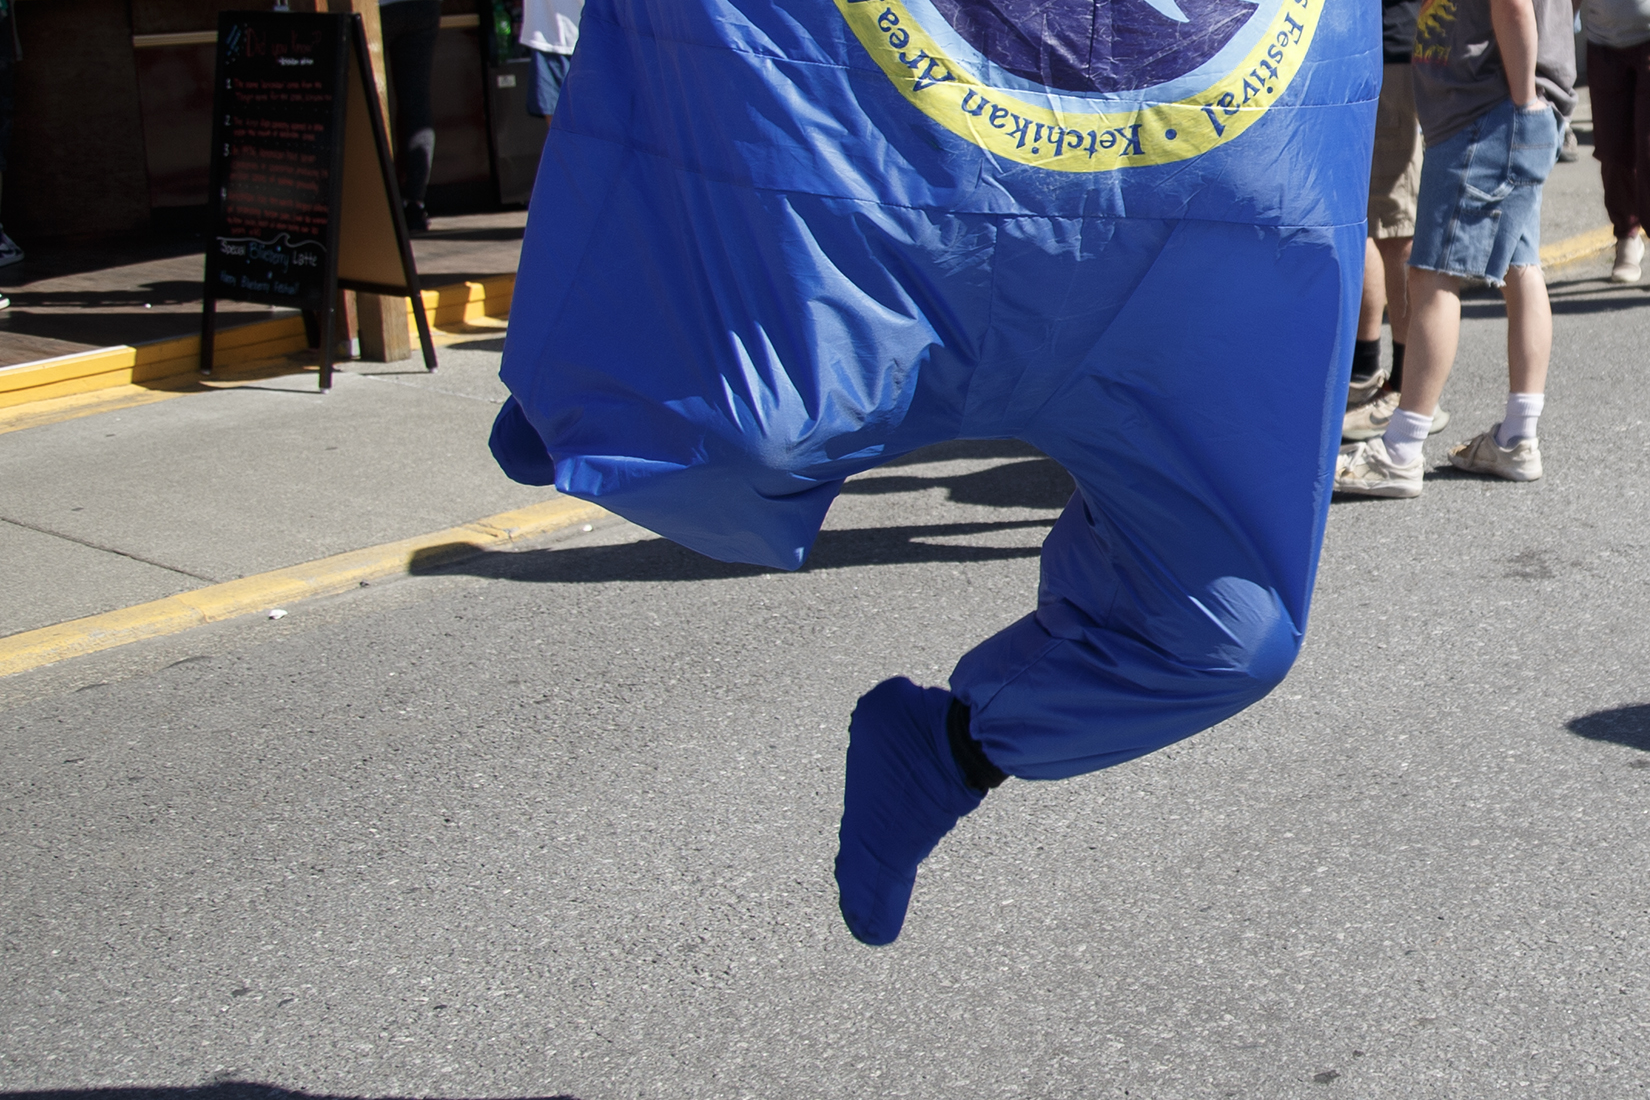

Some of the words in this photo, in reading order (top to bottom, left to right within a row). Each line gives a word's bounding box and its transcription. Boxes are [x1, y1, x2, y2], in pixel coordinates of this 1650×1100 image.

[877, 7, 957, 92] Area
[1200, 12, 1304, 138] Festival
[960, 88, 1146, 158] Ketchikan
[292, 250, 318, 268] Latte
